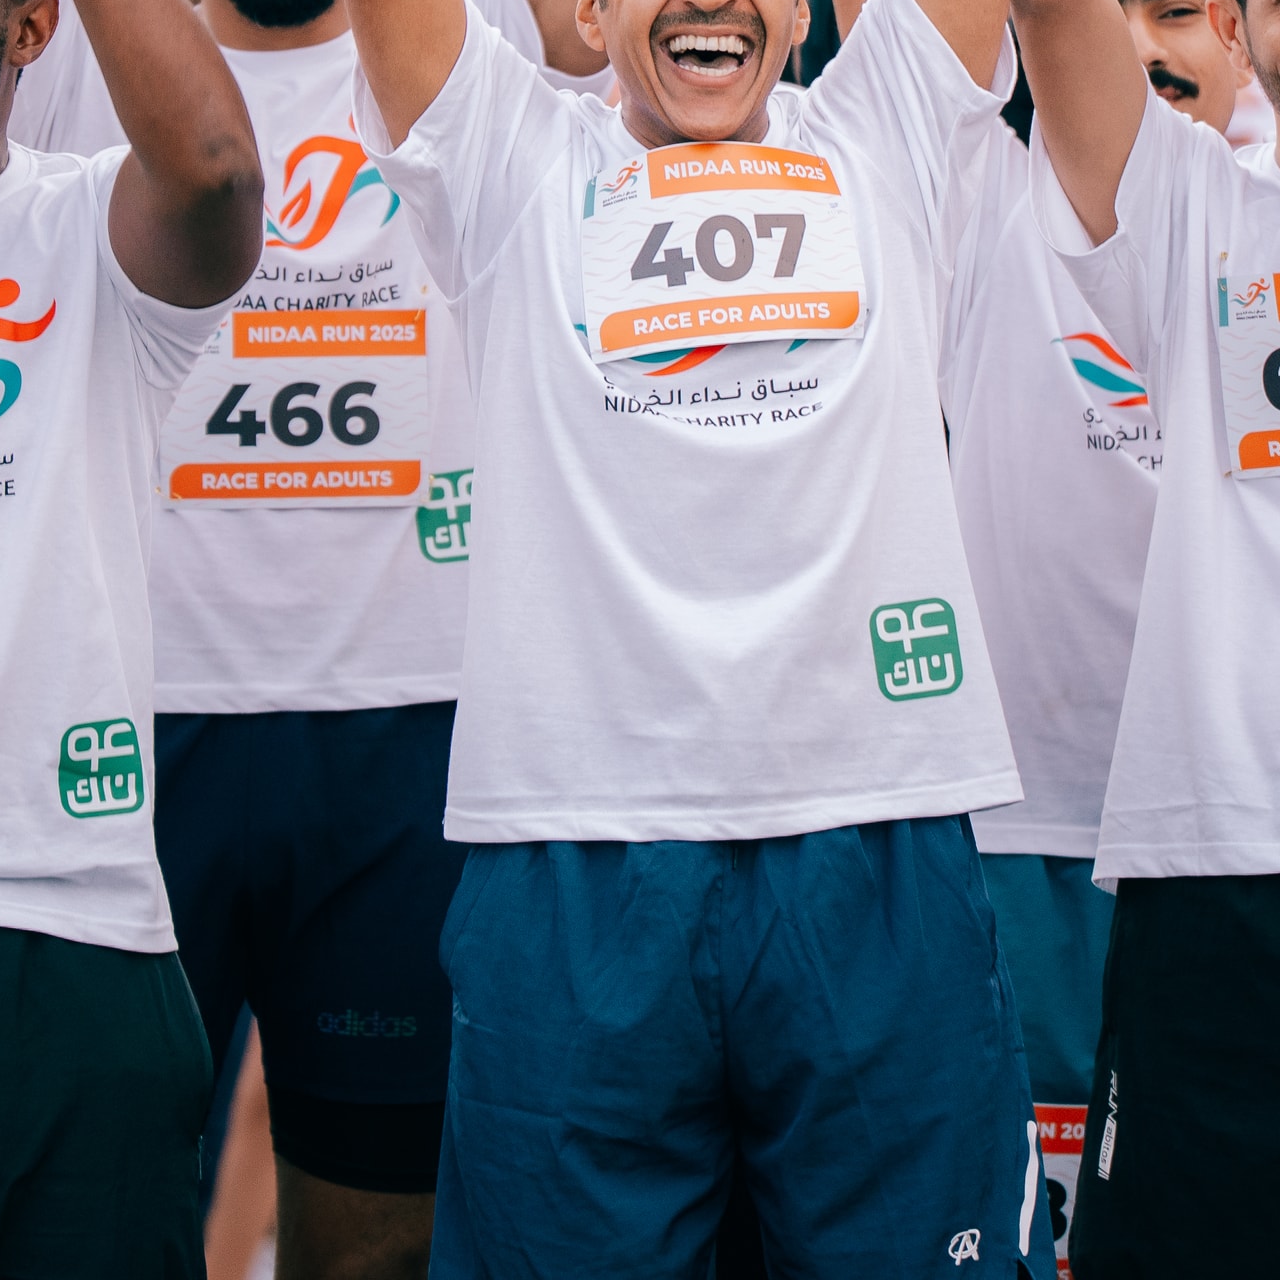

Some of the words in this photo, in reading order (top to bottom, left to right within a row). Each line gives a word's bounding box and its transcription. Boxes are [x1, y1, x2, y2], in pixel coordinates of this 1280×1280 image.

[663, 159, 736, 181] NIDAA
[740, 159, 782, 177] RUN
[783, 162, 827, 182] 2025
[630, 213, 807, 288] 407
[294, 265, 343, 283] نداء
[349, 259, 393, 283] سباق
[273, 294, 356, 312] CHARITY
[361, 284, 401, 307] RACE
[633, 312, 696, 336] RACE
[698, 307, 746, 327] FOR
[749, 302, 831, 322] ADULTS
[248, 326, 318, 344] NIDAA
[322, 325, 365, 342] RUN
[369, 324, 416, 342] 2025
[690, 381, 742, 405] نداء
[751, 377, 818, 400] سباق
[205, 381, 381, 447] 466
[771, 401, 824, 423] RACE
[202, 472, 258, 490] RACE
[263, 472, 307, 489] FOR
[309, 470, 393, 489] ADULTS
[317, 1009, 417, 1037] adidas
[1060, 1123, 1085, 1140] 20
